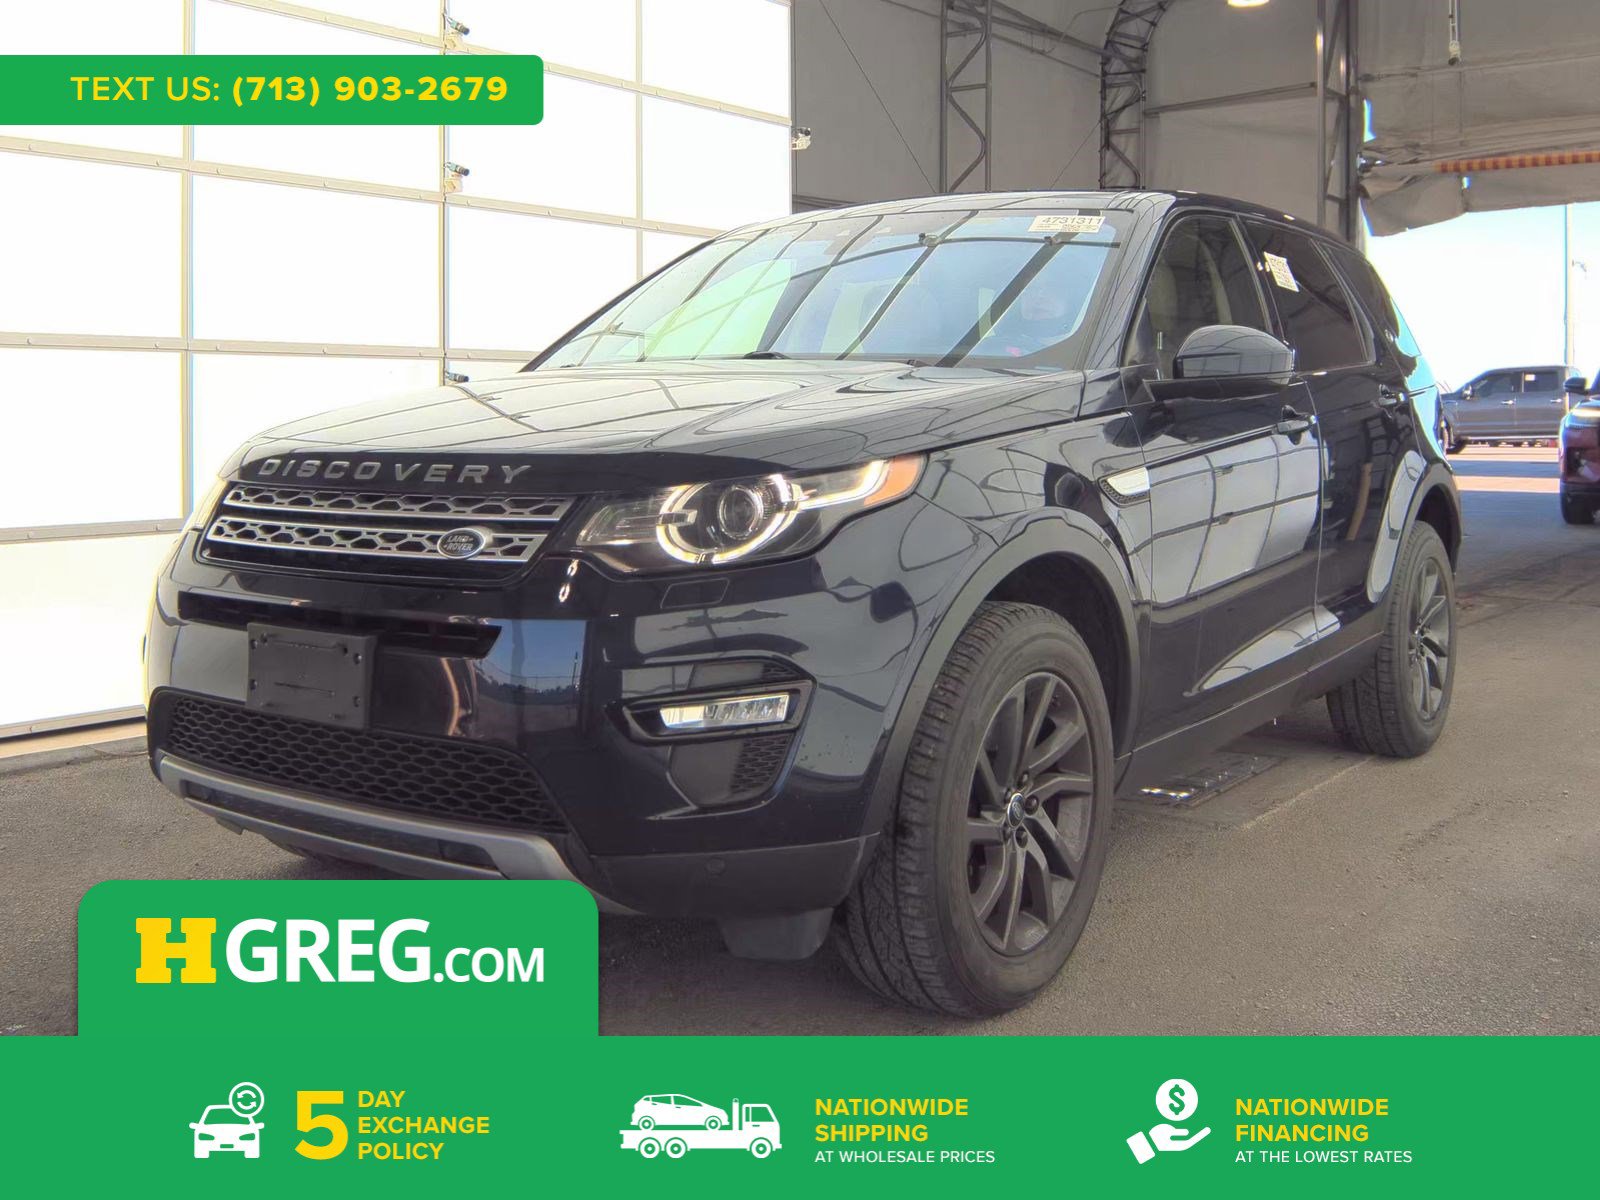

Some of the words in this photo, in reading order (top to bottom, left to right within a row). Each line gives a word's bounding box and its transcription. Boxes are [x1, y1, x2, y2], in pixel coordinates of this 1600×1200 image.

[258, 458, 532, 484] DISCOVERY
[447, 534, 470, 543] LAND
[446, 543, 474, 551] ROVER
